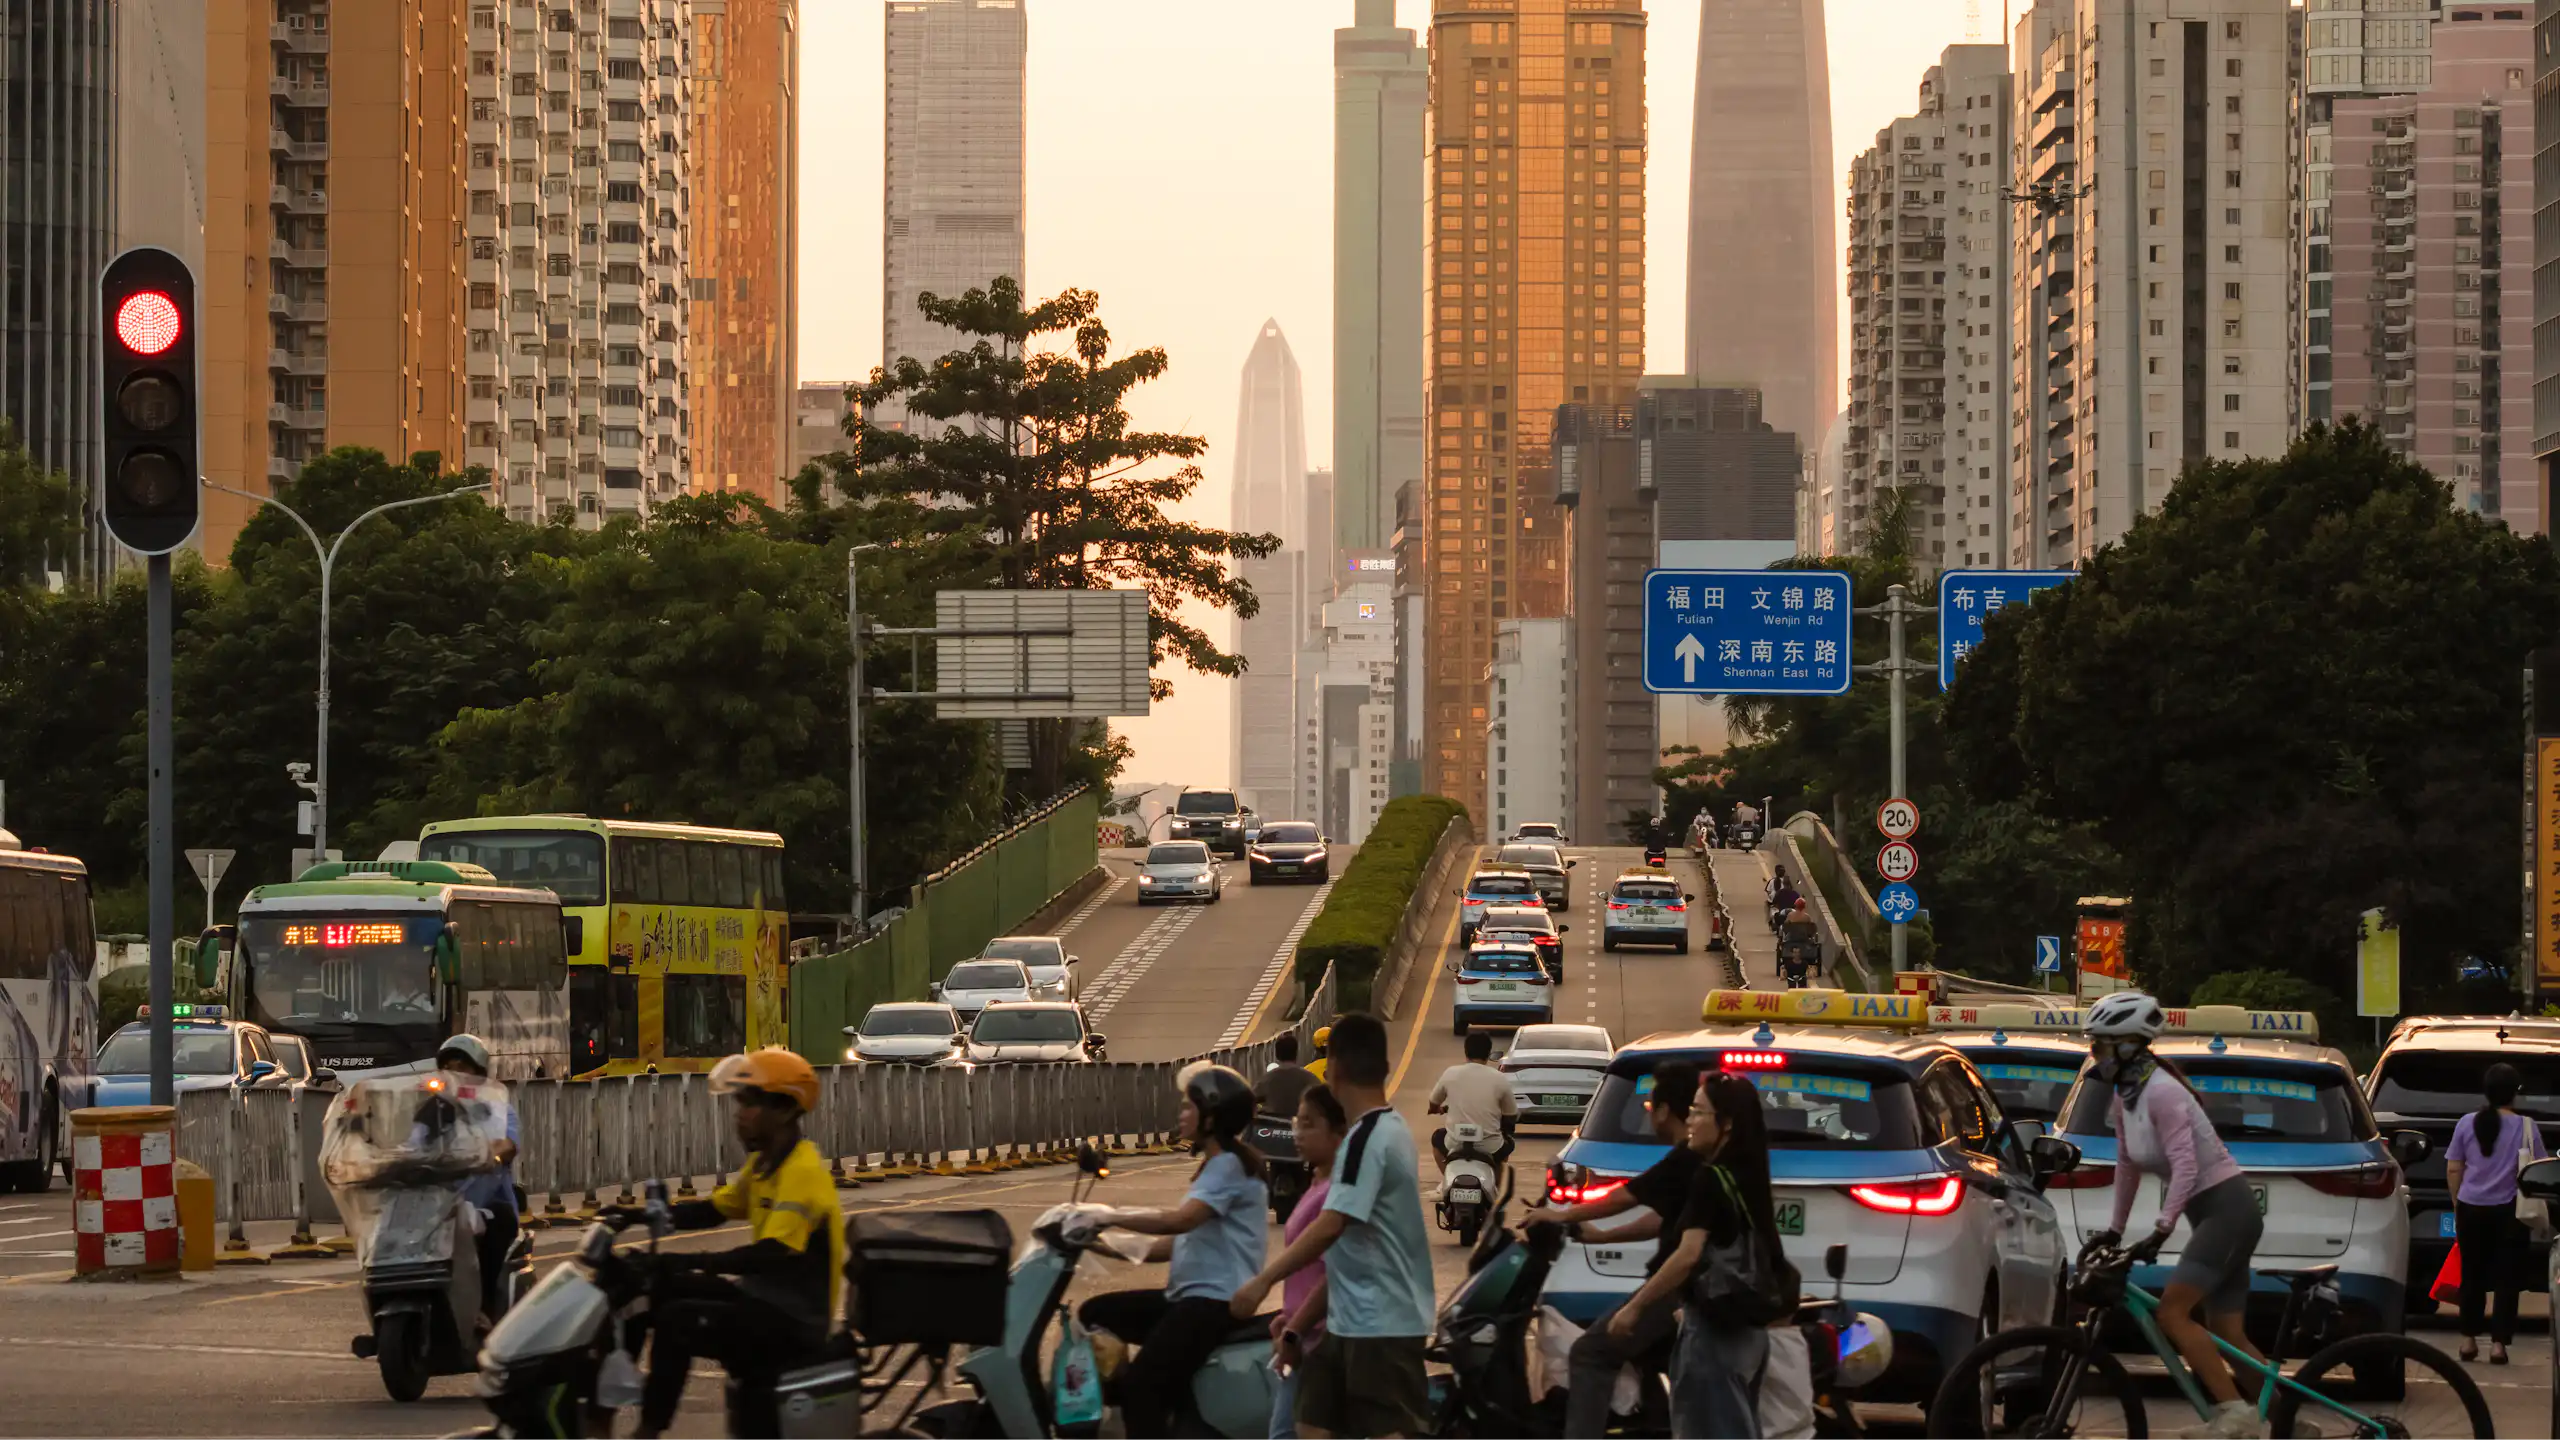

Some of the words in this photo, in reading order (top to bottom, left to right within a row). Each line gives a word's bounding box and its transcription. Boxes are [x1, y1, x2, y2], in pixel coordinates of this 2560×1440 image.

[1666, 585, 1725, 610] 福田
[1751, 586, 1836, 611] 文锦路
[1952, 586, 2006, 611] 布吉
[1677, 613, 1714, 625] Futian
[1763, 614, 1800, 628] Wenjin
[1807, 614, 1823, 626] Rd
[1717, 639, 1838, 664] 深南东路
[1723, 666, 1775, 678] Shennan
[1782, 667, 1809, 678] East
[1817, 667, 1834, 679] Rd
[1716, 992, 1780, 1013] 深圳
[1848, 997, 1911, 1018] TAXI
[1934, 1008, 1977, 1024] 深圳
[2032, 1011, 2081, 1025] TAXI
[2166, 1010, 2187, 1028] 圳
[2249, 1012, 2304, 1031] TAXI
